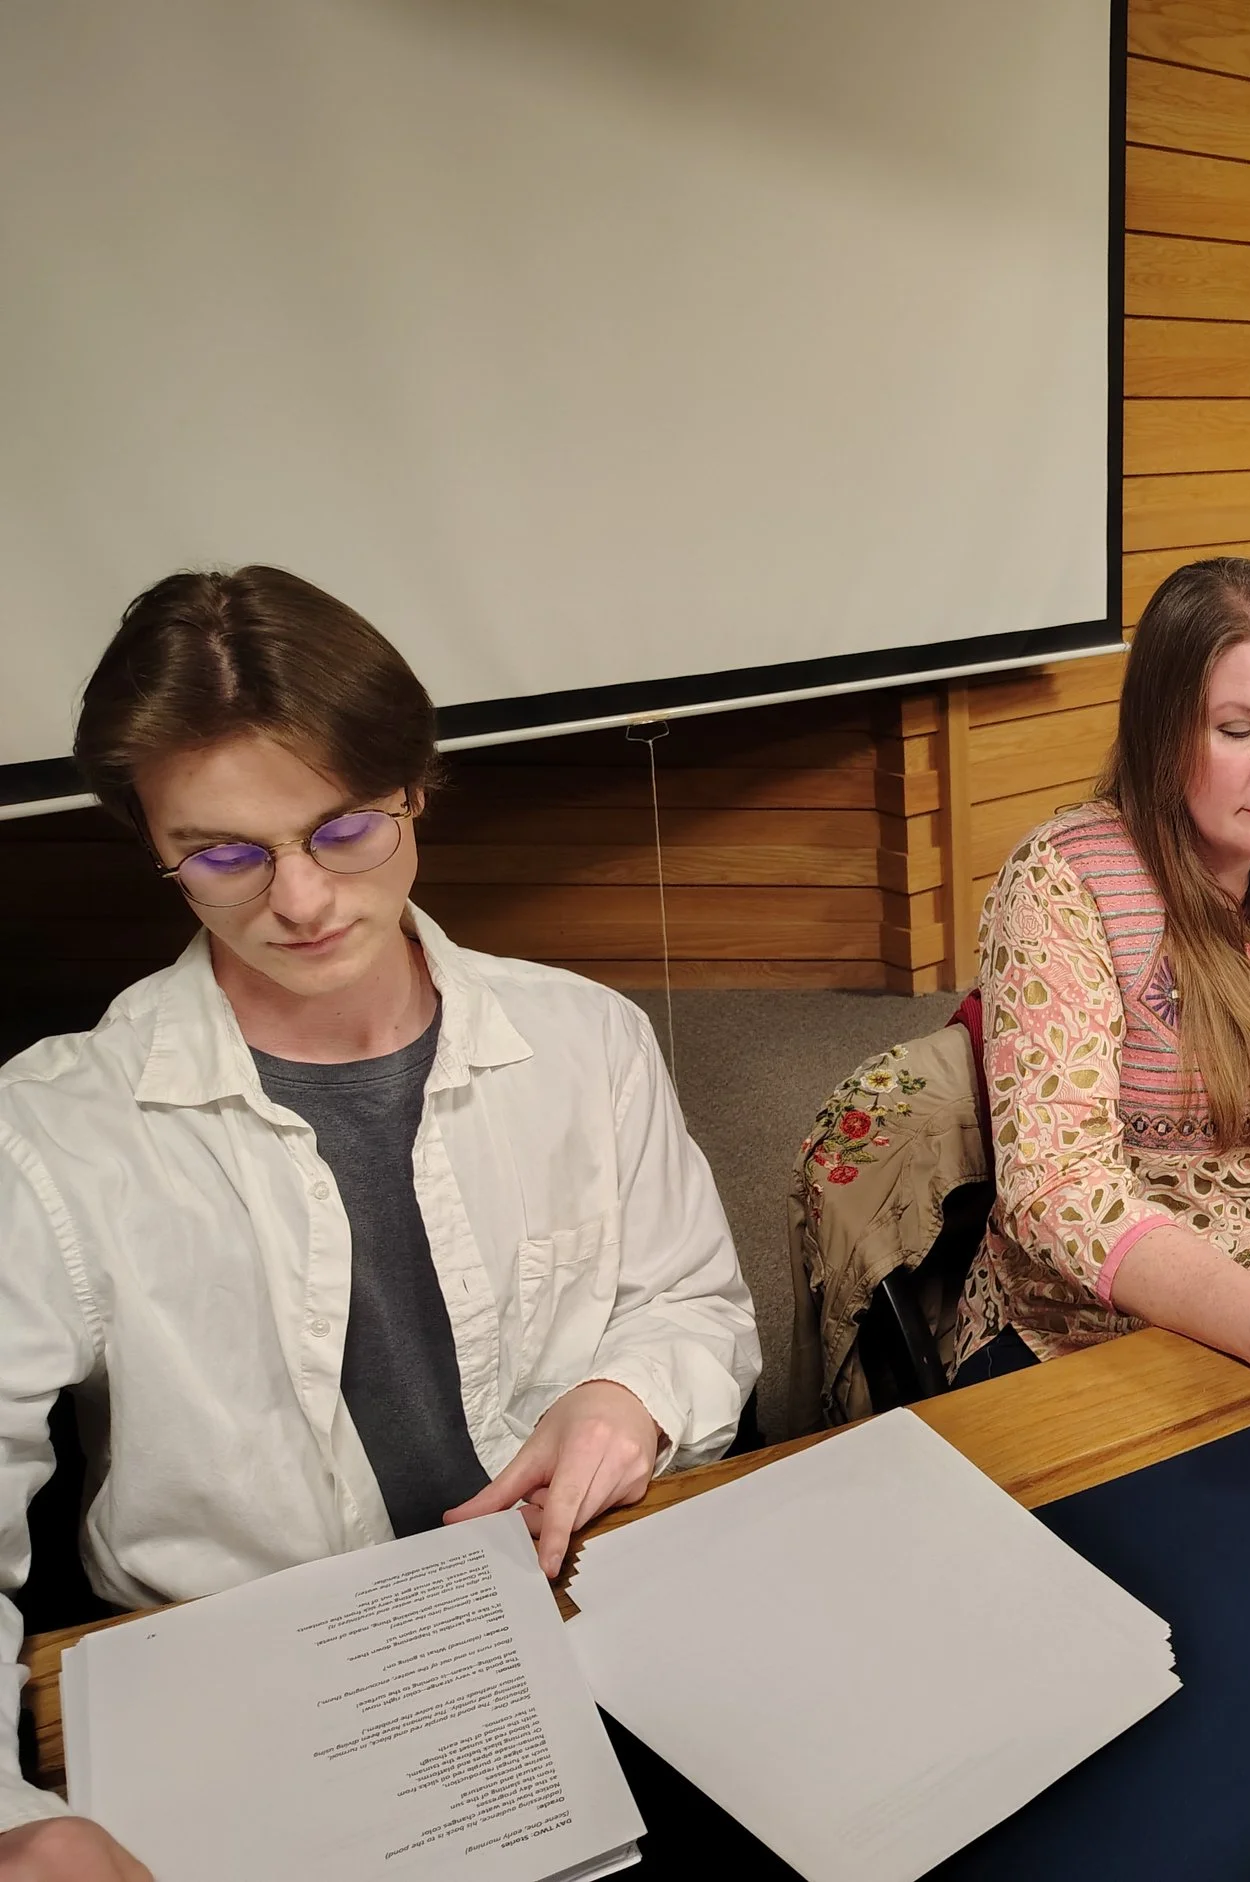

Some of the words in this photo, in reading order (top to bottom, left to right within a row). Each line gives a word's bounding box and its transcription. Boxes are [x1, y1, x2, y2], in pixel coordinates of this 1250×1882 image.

[433, 1611, 471, 1628] judgement
[465, 1608, 504, 1623] Something
[438, 1620, 465, 1632] terrible
[483, 1625, 509, 1637] Oracle:
[392, 1631, 431, 1647] happening
[398, 1629, 417, 1639] upon
[370, 1644, 392, 1654] down
[426, 1646, 447, 1656] What
[476, 1644, 493, 1653] runs
[397, 1654, 418, 1665] going
[485, 1660, 504, 1671] pond
[495, 1662, 521, 1674] Simon:
[391, 1670, 416, 1681] water,
[454, 1672, 471, 1681] very
[498, 1674, 525, 1687] various
[343, 1678, 390, 1697] encouraging
[411, 1676, 439, 1689] coming
[493, 1680, 527, 1696] steaming
[466, 1684, 497, 1699] methods
[316, 1694, 342, 1708] them.)
[382, 1696, 401, 1706] right
[510, 1693, 531, 1705] Scene
[361, 1703, 382, 1713] now!
[414, 1705, 434, 1716] solve
[457, 1704, 476, 1717] pond
[491, 1701, 509, 1711] One:
[402, 1713, 432, 1727] humans
[424, 1714, 448, 1727] purple
[481, 1714, 513, 1728] cosmos.
[520, 1713, 538, 1723] with
[361, 1717, 399, 1735] problem.)
[381, 1724, 401, 1735] have
[483, 1724, 506, 1737] mood
[508, 1723, 530, 1736] blood
[360, 1731, 380, 1742] been
[368, 1734, 392, 1746] black,
[502, 1730, 531, 1744] turning
[335, 1738, 360, 1750] diving
[437, 1741, 459, 1752] earth
[458, 1740, 483, 1753] sunset
[482, 1740, 503, 1751] black
[524, 1739, 547, 1751] green
[313, 1747, 334, 1758] using
[456, 1748, 482, 1760] before
[472, 1751, 493, 1762] pipes
[503, 1748, 523, 1759] algae
[531, 1747, 549, 1757] such
[419, 1752, 448, 1766] though
[466, 1759, 492, 1772] purple
[495, 1757, 520, 1771] fungal
[523, 1753, 551, 1767] marine
[405, 1763, 440, 1779] tsunami,
[415, 1764, 455, 1782] platforms.
[441, 1766, 495, 1788] reproduction,
[484, 1763, 523, 1781] processes
[515, 1764, 543, 1779] natural
[536, 1768, 556, 1778] from
[417, 1778, 439, 1789] slicks
[460, 1781, 498, 1799] unnatural
[490, 1780, 521, 1795] slanting
[534, 1781, 561, 1794] Notice
[396, 1786, 417, 1797] from
[475, 1788, 518, 1808] progresses
[517, 1788, 562, 1809] (addressing
[536, 1796, 565, 1810] Oracle:
[477, 1804, 501, 1816] water
[479, 1805, 517, 1823] audience,
[543, 1809, 570, 1824] (Scene
[442, 1813, 476, 1829] changes
[524, 1821, 543, 1831] One,
[420, 1825, 442, 1837] color
[445, 1825, 465, 1836] back
[502, 1828, 523, 1840] early
[464, 1836, 501, 1855] morning)
[500, 1834, 529, 1849] Stories
[384, 1844, 410, 1860] pond)
